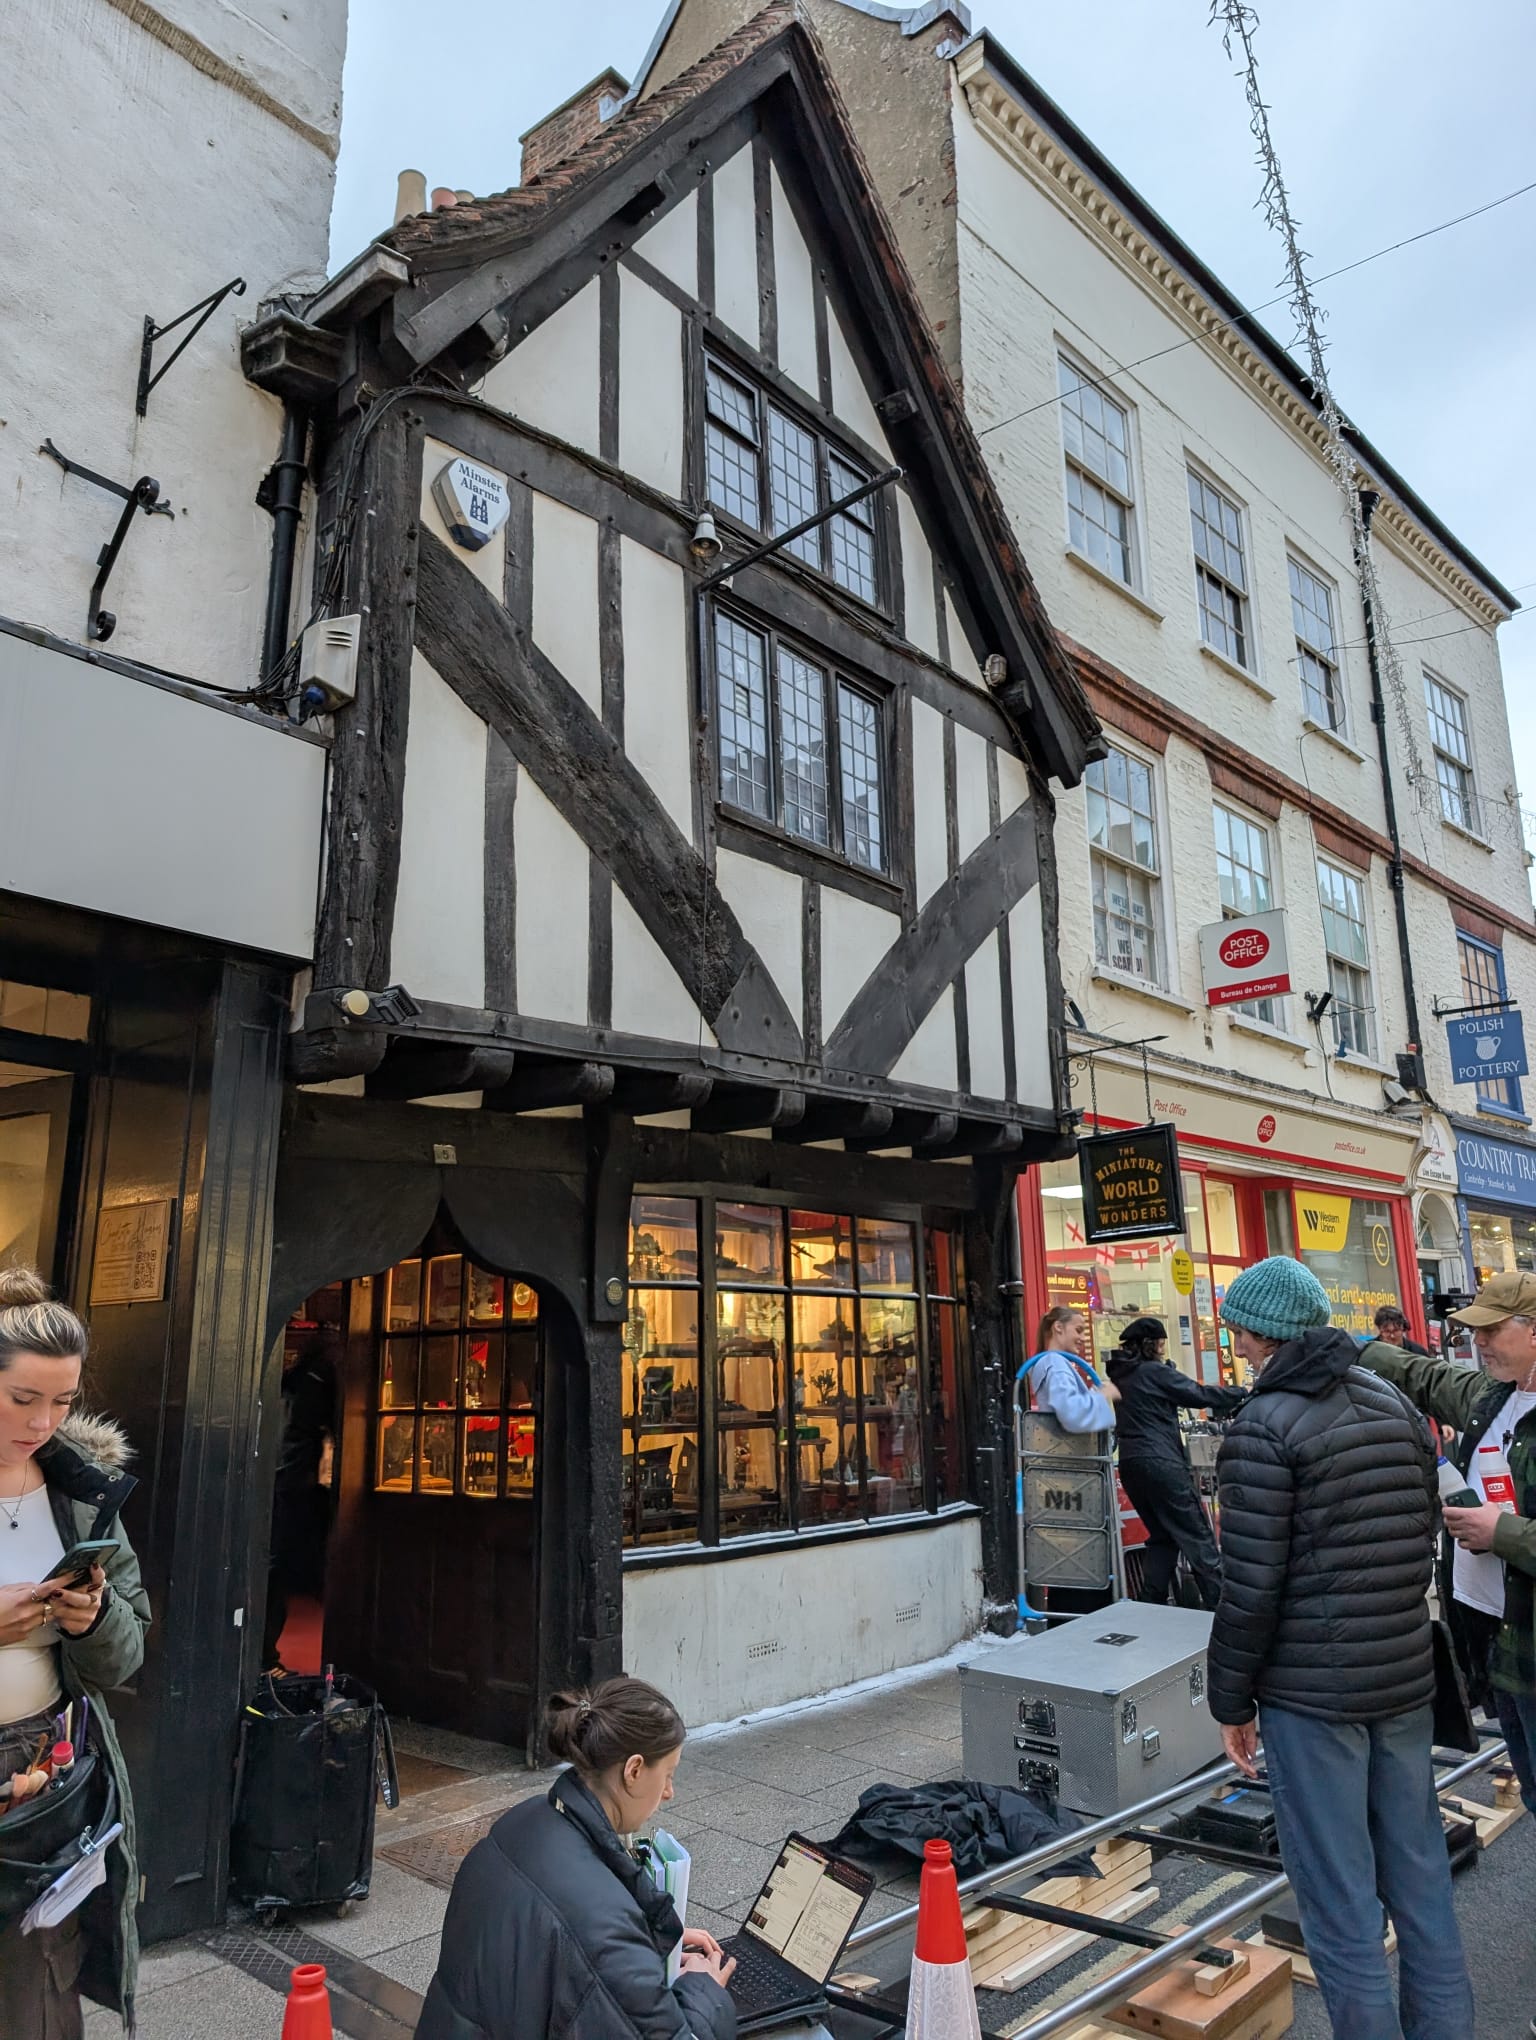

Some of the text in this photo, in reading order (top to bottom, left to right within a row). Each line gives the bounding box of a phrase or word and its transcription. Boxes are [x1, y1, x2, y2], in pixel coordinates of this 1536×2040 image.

[459, 463, 502, 493] Minster
[460, 478, 500, 504] Alarms
[1230, 934, 1259, 950] POST
[1224, 945, 1265, 962] OFFICE
[1220, 982, 1278, 999] Bureau de Change
[1459, 1018, 1504, 1035] POLISH
[1459, 1060, 1520, 1079] POTTERY
[1154, 1099, 1187, 1116] Post Office
[1258, 1128, 1273, 1137] OFFICE
[1262, 1120, 1274, 1129] POST
[1118, 1147, 1136, 1155] THE
[1459, 1140, 1513, 1176] COUNTRY
[1095, 1157, 1163, 1182] MINIATURE
[1102, 1178, 1159, 1200] WORLD
[1100, 1206, 1167, 1225] WONDERS
[1319, 1211, 1340, 1223] Western
[1320, 1222, 1336, 1233] Union
[1340, 1286, 1359, 1304] and
[1361, 1289, 1396, 1307] receive
[1351, 1311, 1374, 1330] here
[1044, 1489, 1082, 1511] NH
